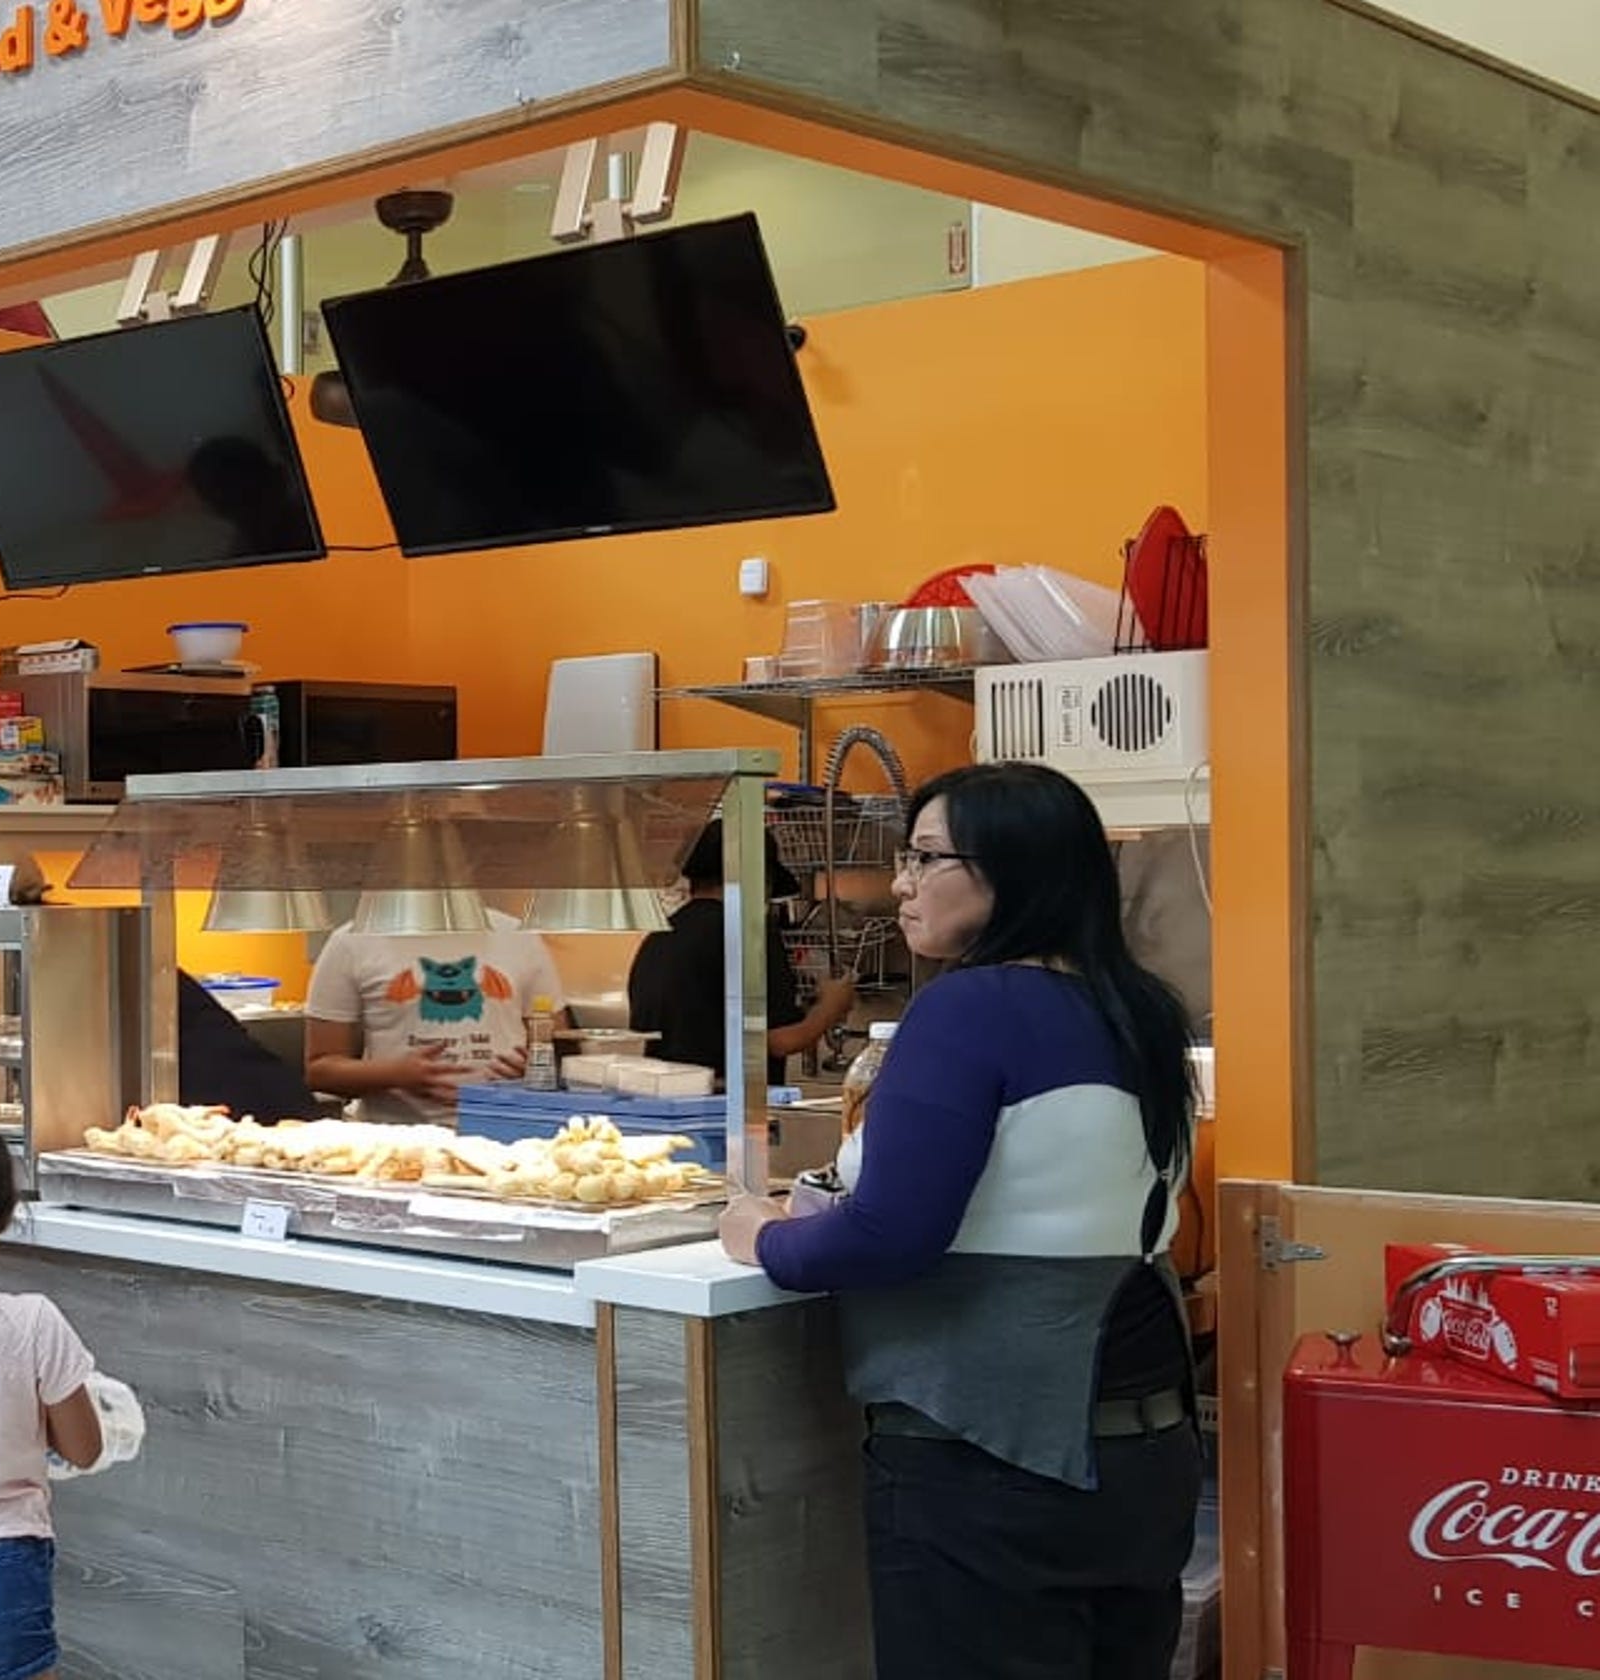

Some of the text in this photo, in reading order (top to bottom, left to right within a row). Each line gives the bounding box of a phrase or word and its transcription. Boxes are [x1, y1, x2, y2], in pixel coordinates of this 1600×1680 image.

[43, 0, 89, 56] &
[1500, 1466, 1600, 1492] DRINK
[1433, 1584, 1522, 1609] ICE
